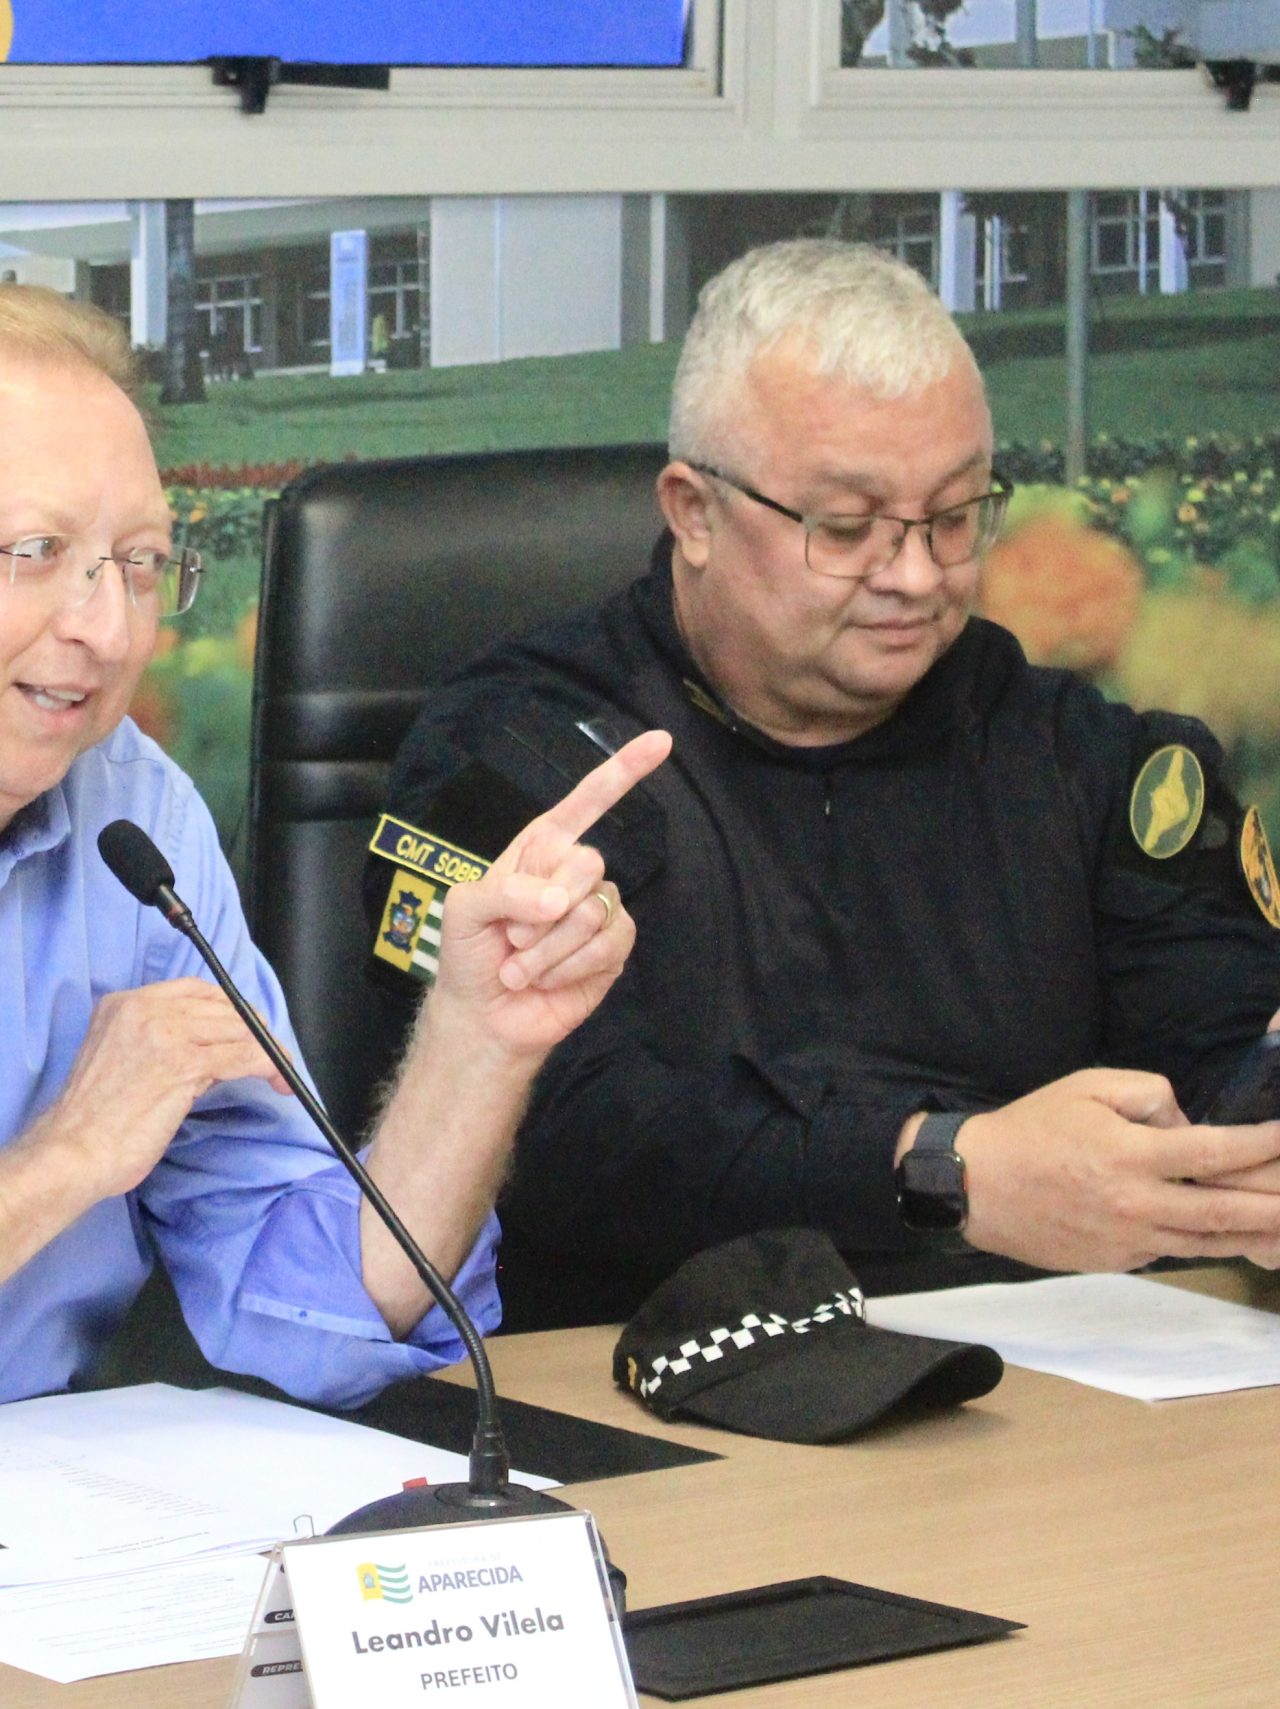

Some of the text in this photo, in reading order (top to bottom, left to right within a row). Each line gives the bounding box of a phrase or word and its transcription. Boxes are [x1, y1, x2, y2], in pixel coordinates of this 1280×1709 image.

[396, 835, 435, 866] CMT
[418, 1565, 524, 1593] APARECIDA
[351, 1607, 565, 1654] Leandro Vilela
[420, 1663, 519, 1690] PREFEITO
